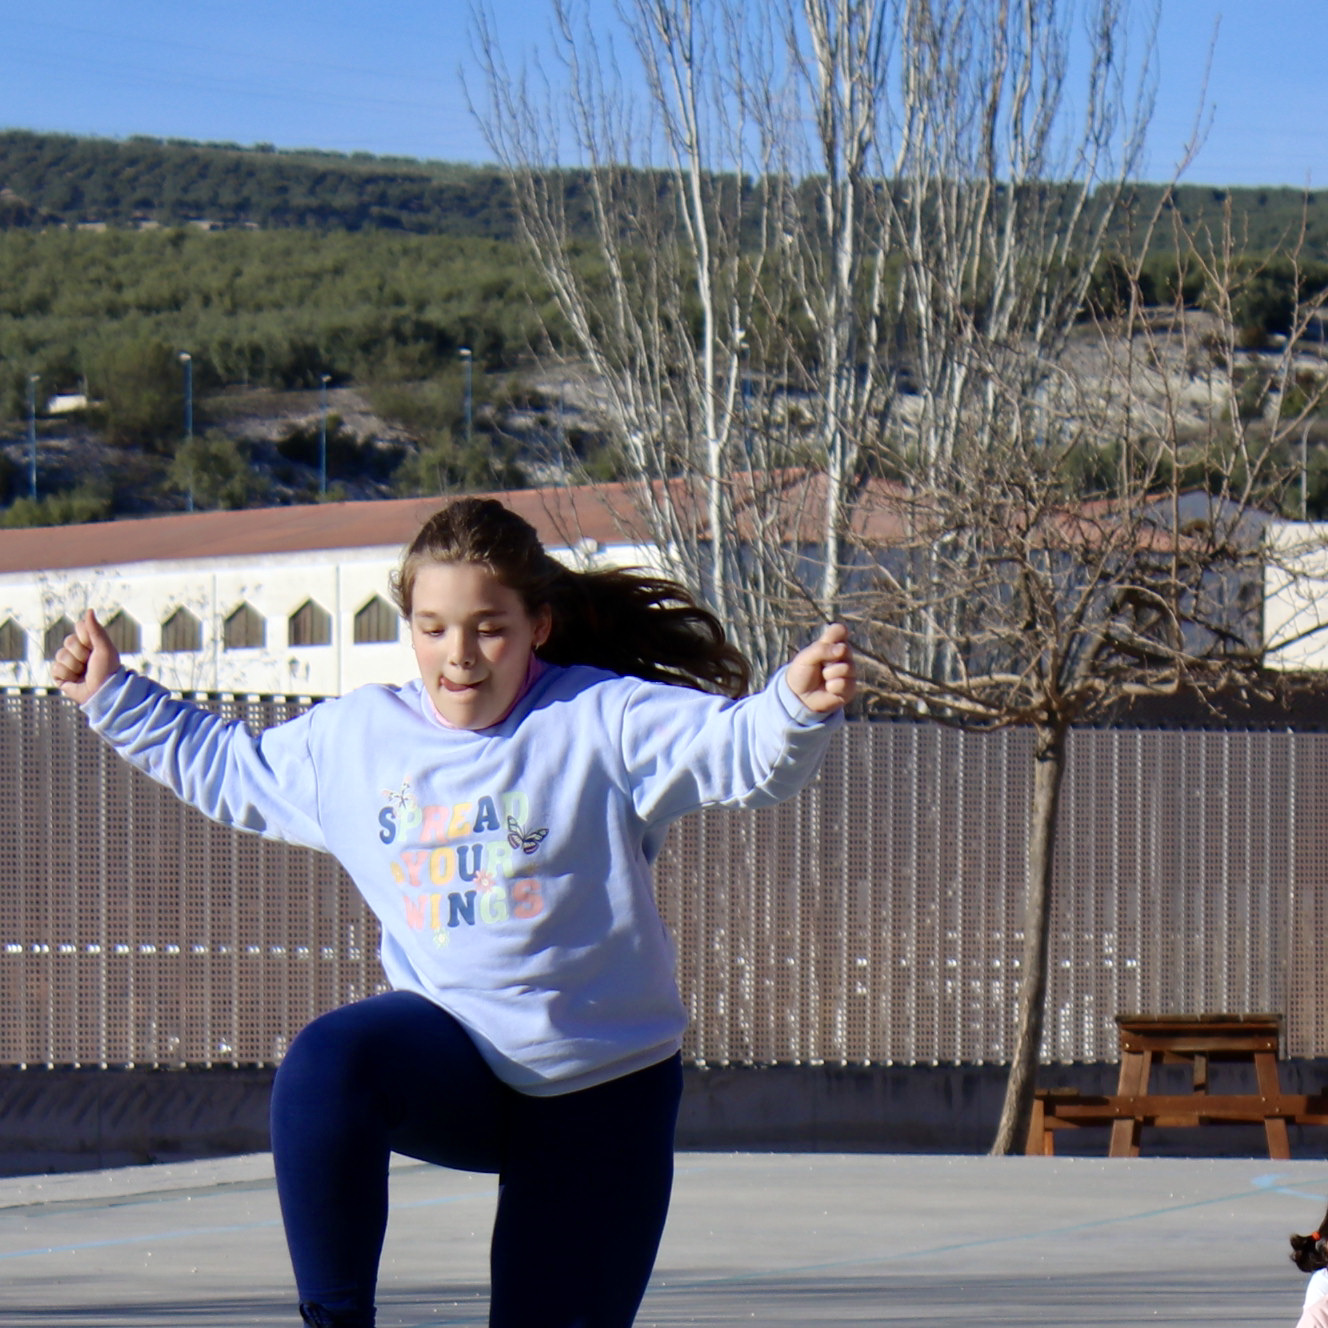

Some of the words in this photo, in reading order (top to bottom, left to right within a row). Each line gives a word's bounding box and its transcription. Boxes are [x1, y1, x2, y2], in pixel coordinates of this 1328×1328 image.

[378, 791, 529, 844] SPREAD
[400, 841, 514, 887] YOUR
[403, 879, 545, 930] WINGS
